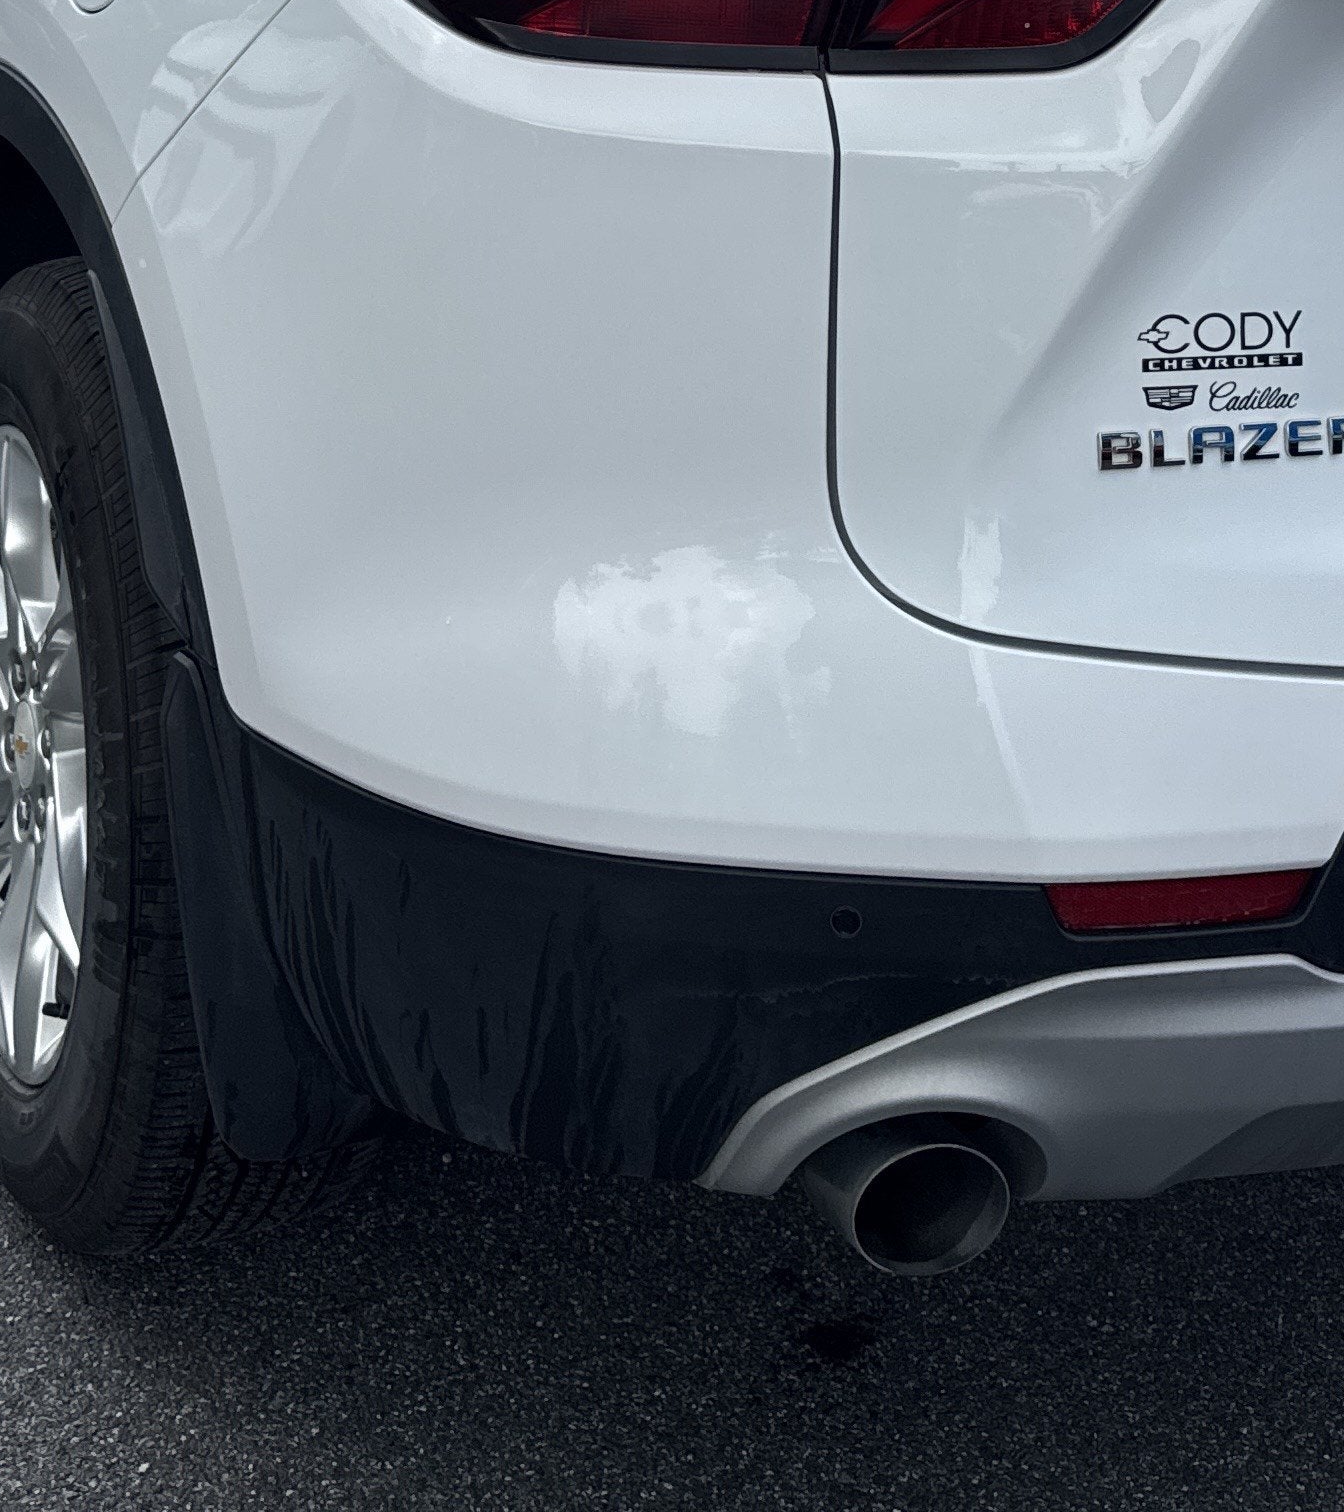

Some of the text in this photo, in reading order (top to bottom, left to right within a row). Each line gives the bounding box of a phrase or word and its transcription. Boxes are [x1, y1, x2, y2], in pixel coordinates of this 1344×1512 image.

[1148, 310, 1303, 354] CODY
[1147, 353, 1298, 371] CHEVROLET
[1208, 381, 1300, 412] Cadillac
